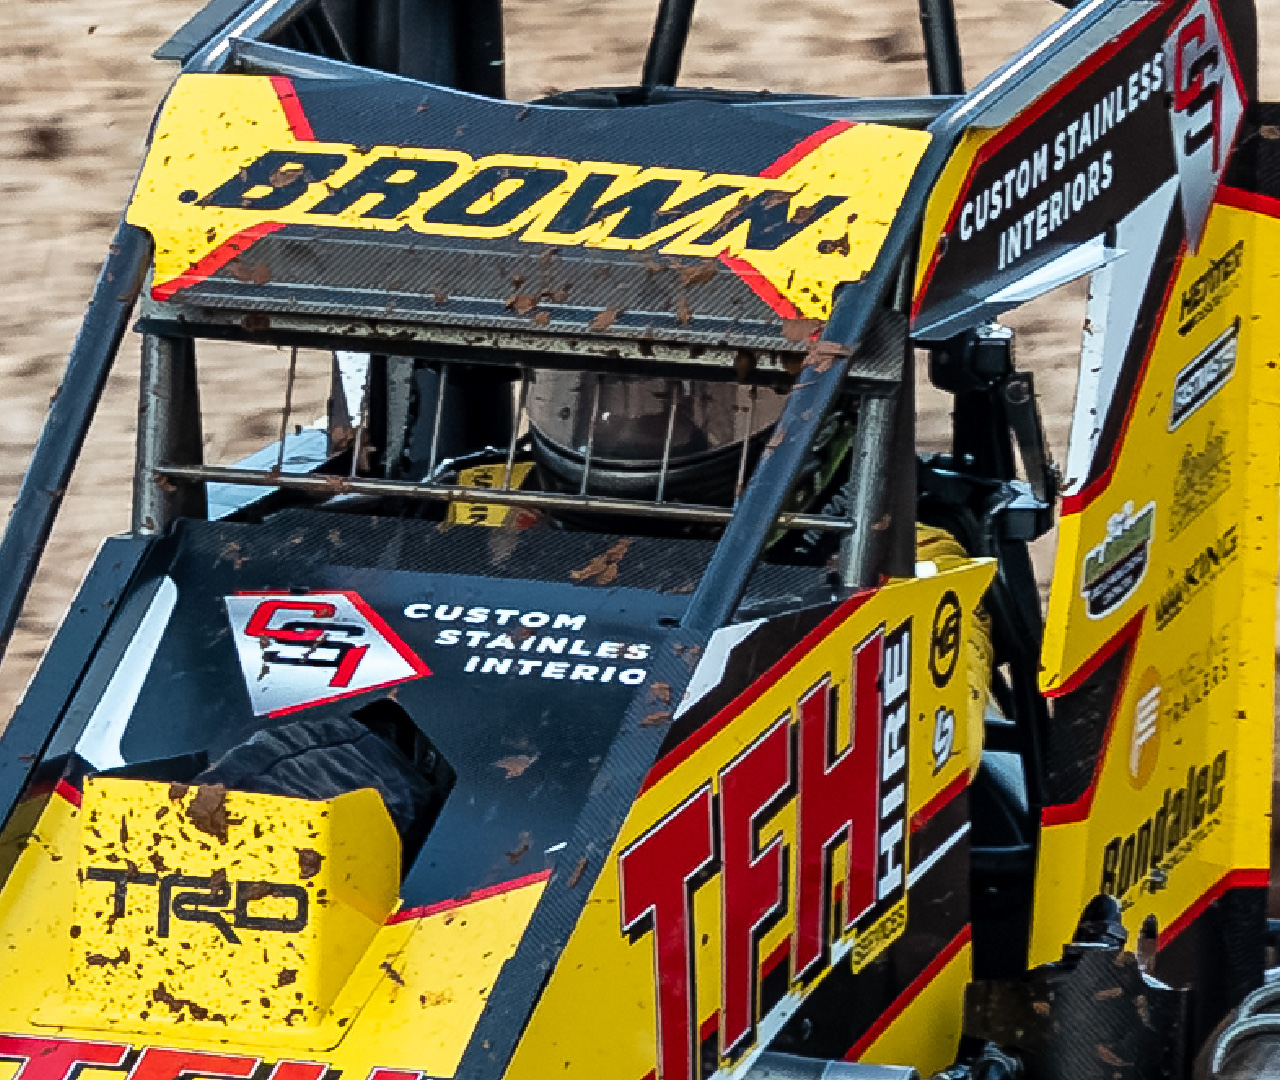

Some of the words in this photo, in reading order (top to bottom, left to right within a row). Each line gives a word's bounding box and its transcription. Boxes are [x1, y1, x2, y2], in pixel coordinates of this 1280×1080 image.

[200, 147, 851, 252] BROWN
[959, 142, 1049, 241] CUSTOM
[1052, 51, 1166, 172] STAINLESS
[997, 151, 1115, 272] INTERIORS
[403, 603, 587, 631] CUSTOM
[876, 629, 911, 902] HIRE
[86, 867, 310, 944] TRD
